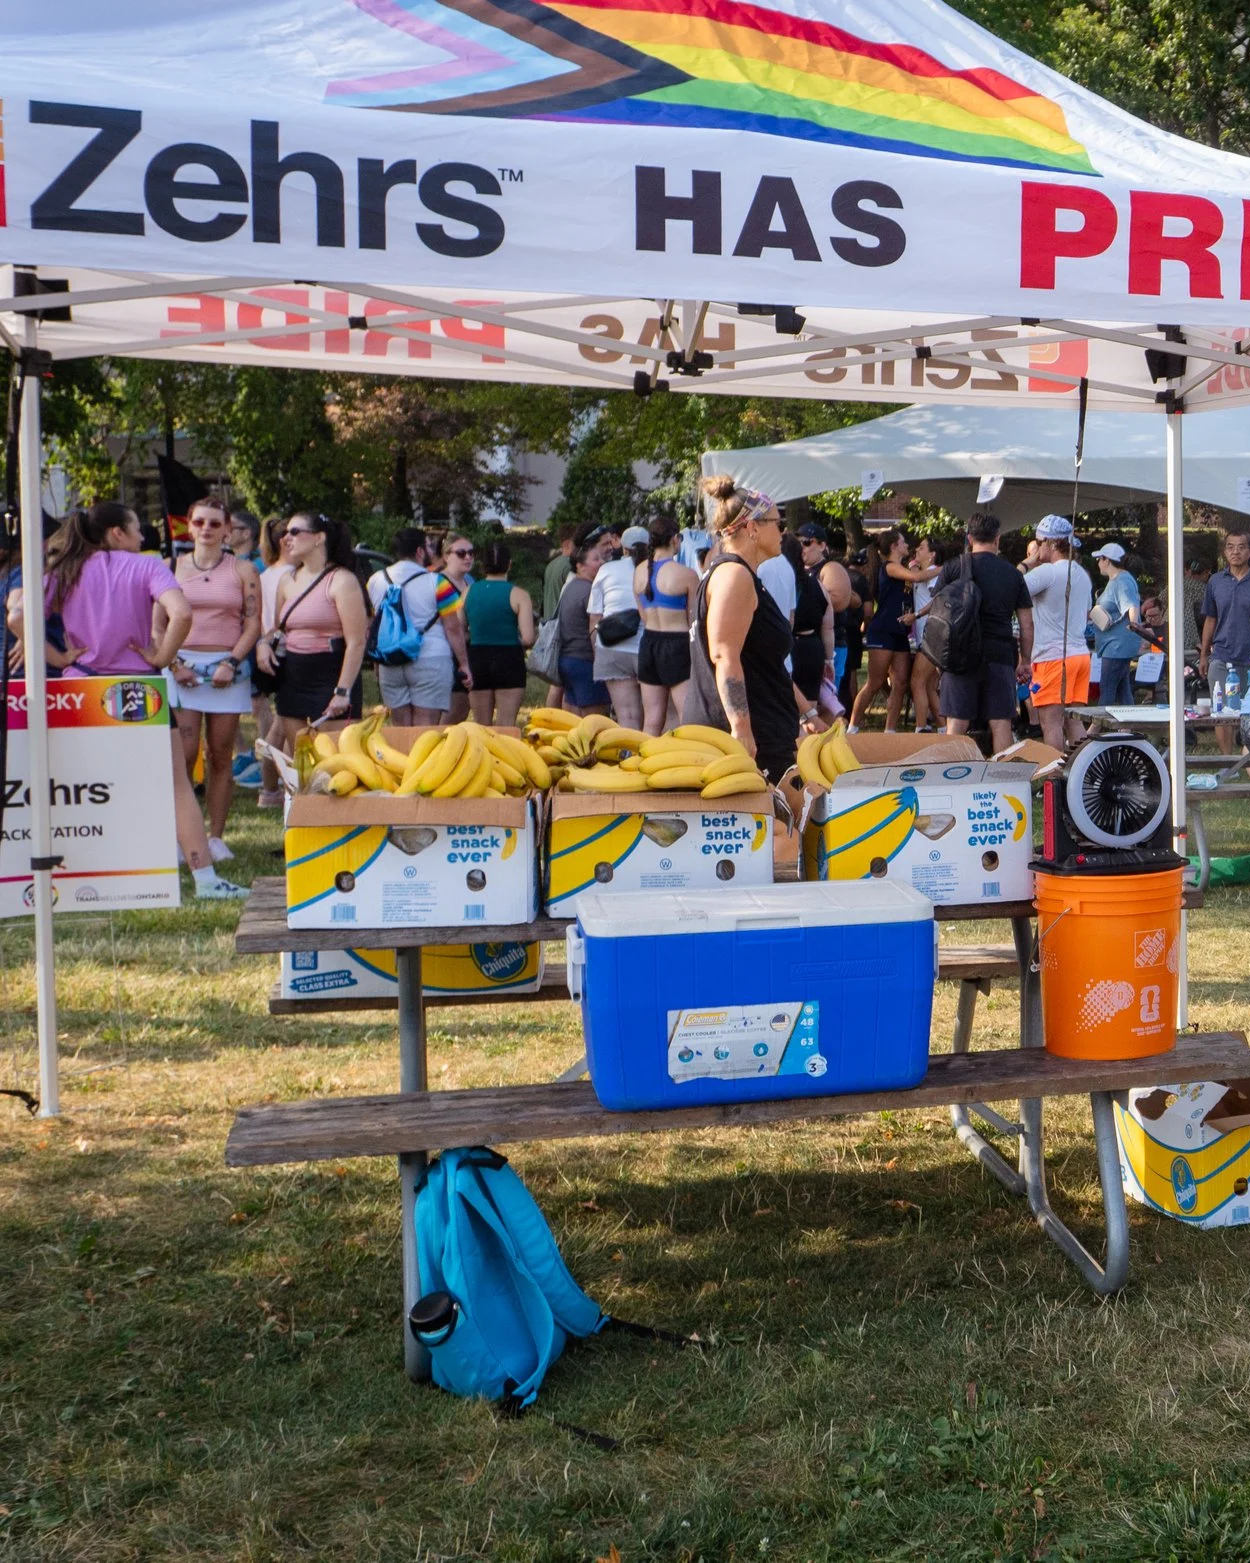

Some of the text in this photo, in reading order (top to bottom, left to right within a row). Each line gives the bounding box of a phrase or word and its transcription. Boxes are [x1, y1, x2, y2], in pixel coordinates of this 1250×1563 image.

[635, 164, 907, 268] HAS
[2, 778, 110, 808] Zhrs
[973, 791, 997, 800] likely
[967, 807, 1000, 820] best
[701, 814, 738, 827] best
[972, 818, 1013, 832] snack
[447, 824, 486, 835] best
[706, 827, 751, 840] snack
[451, 835, 500, 848] snack
[968, 834, 1006, 846] ever
[701, 843, 744, 854] ever
[447, 852, 492, 864] ever
[481, 946, 526, 977] Chiquita
[299, 978, 350, 992] CLASS EXTRA
[800, 1018, 814, 1027] 48
[801, 1037, 814, 1046] 63
[809, 1063, 817, 1073] 3
